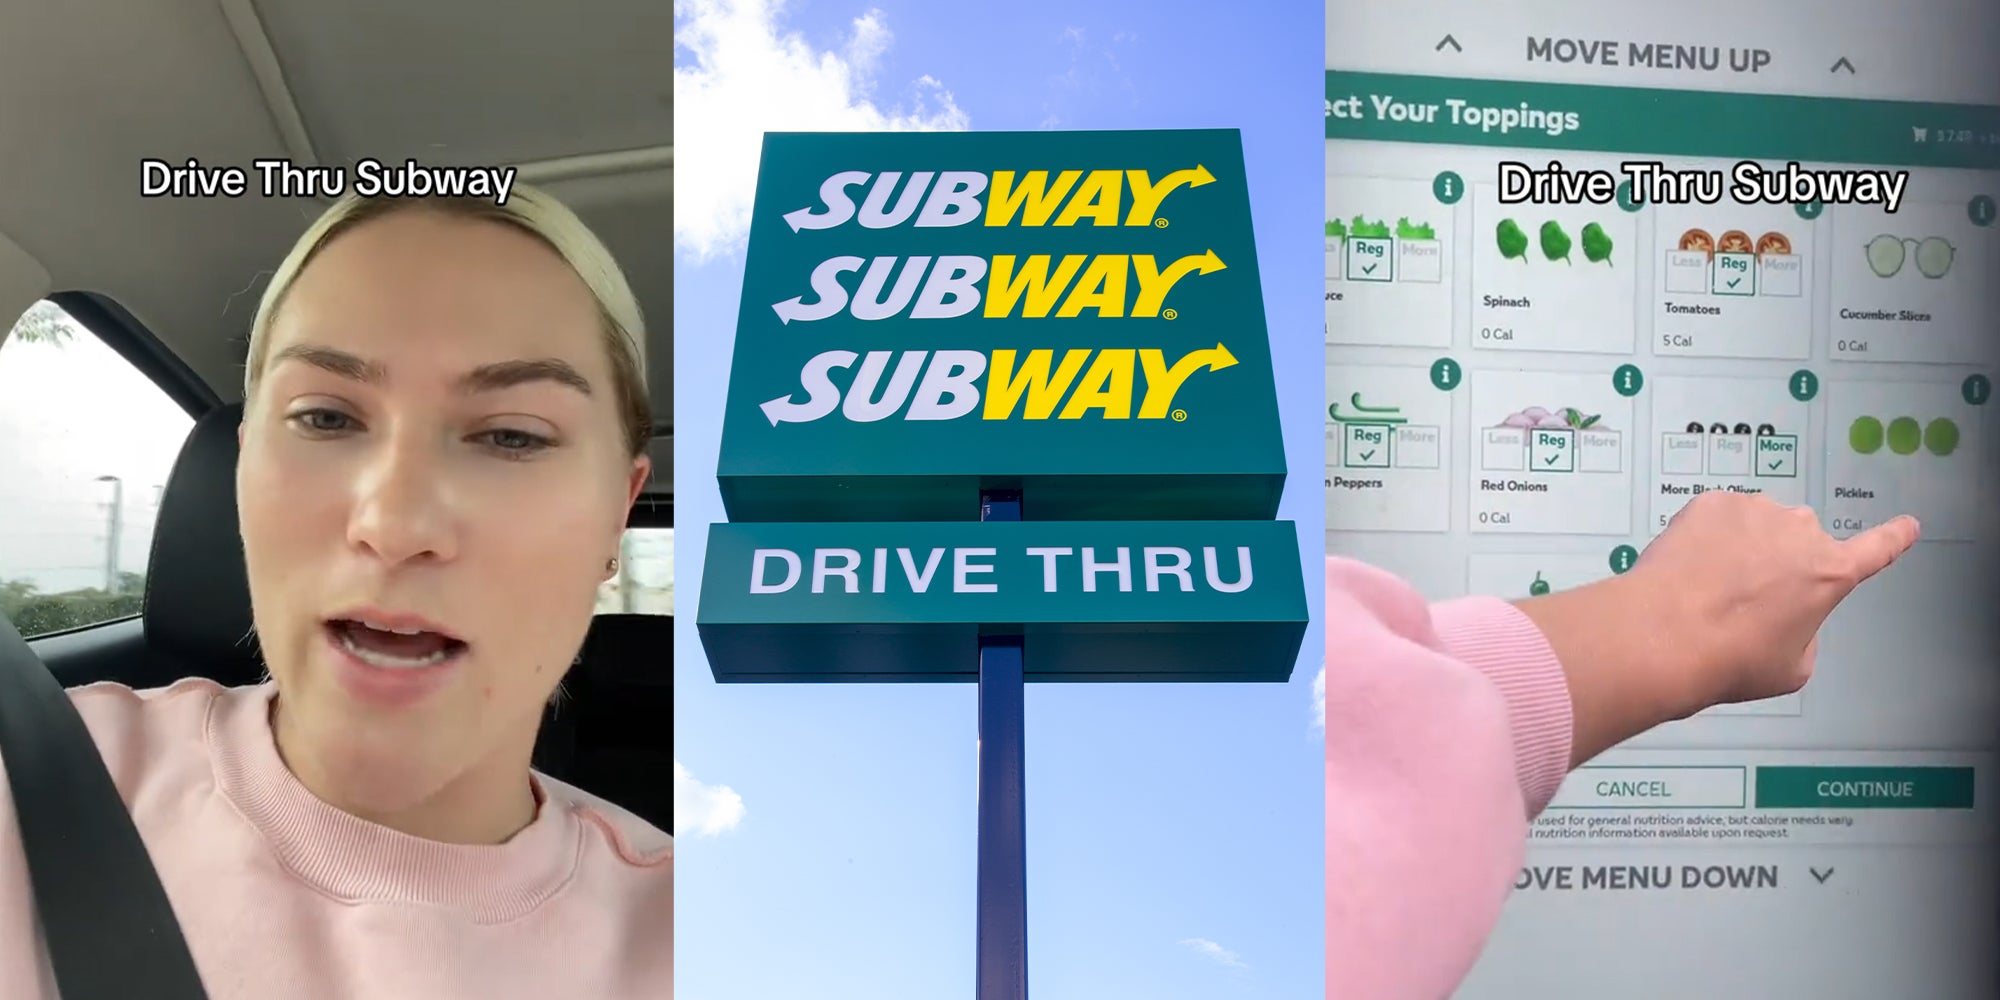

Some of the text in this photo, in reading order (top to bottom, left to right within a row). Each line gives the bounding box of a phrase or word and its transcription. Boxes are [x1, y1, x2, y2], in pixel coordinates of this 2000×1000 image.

[1527, 36, 1771, 73] MOVE MENU UP
[1370, 94, 1439, 123] Your
[1446, 99, 1580, 136] Toppings
[782, 164, 1217, 234] SUBWAY
[1355, 241, 1384, 258] Reg
[1721, 256, 1748, 273] Reg
[771, 248, 1228, 326] SUBWAY
[1483, 294, 1531, 310] Spinach
[1664, 302, 1721, 316] Tomatoes
[1840, 308, 1897, 321] Cucumber
[1481, 327, 1514, 341] 0 Cal
[1663, 334, 1693, 347] 5 Cal
[1838, 340, 1868, 353] 0 Cal
[759, 341, 1240, 428] SUBWAY
[1354, 428, 1382, 444] Reg
[1538, 433, 1566, 450] Reg
[1760, 440, 1793, 452] More
[1334, 476, 1383, 490] Peppers
[1480, 479, 1549, 492] Red Onions
[1661, 483, 1690, 495] More
[1835, 487, 1874, 499] Pickles
[1479, 512, 1511, 524] 0 Cal
[1659, 515, 1667, 527] 5
[1832, 519, 1863, 531] 0 Cal
[749, 546, 1254, 595] DRIVE THRU
[1596, 781, 1672, 797] CANCEL
[1816, 781, 1914, 798] CONTINUE
[1537, 815, 1566, 826] used
[1568, 814, 1585, 826] for
[1587, 815, 1631, 829] general
[1633, 815, 1684, 826] nutrition
[1728, 815, 1749, 826] but
[1535, 828, 1586, 839] nutrition
[1588, 827, 1656, 839] information
[1658, 827, 1709, 838] available
[1711, 829, 1742, 839] upon
[1582, 866, 1672, 890] MENU
[1681, 865, 1778, 889] DOWN
